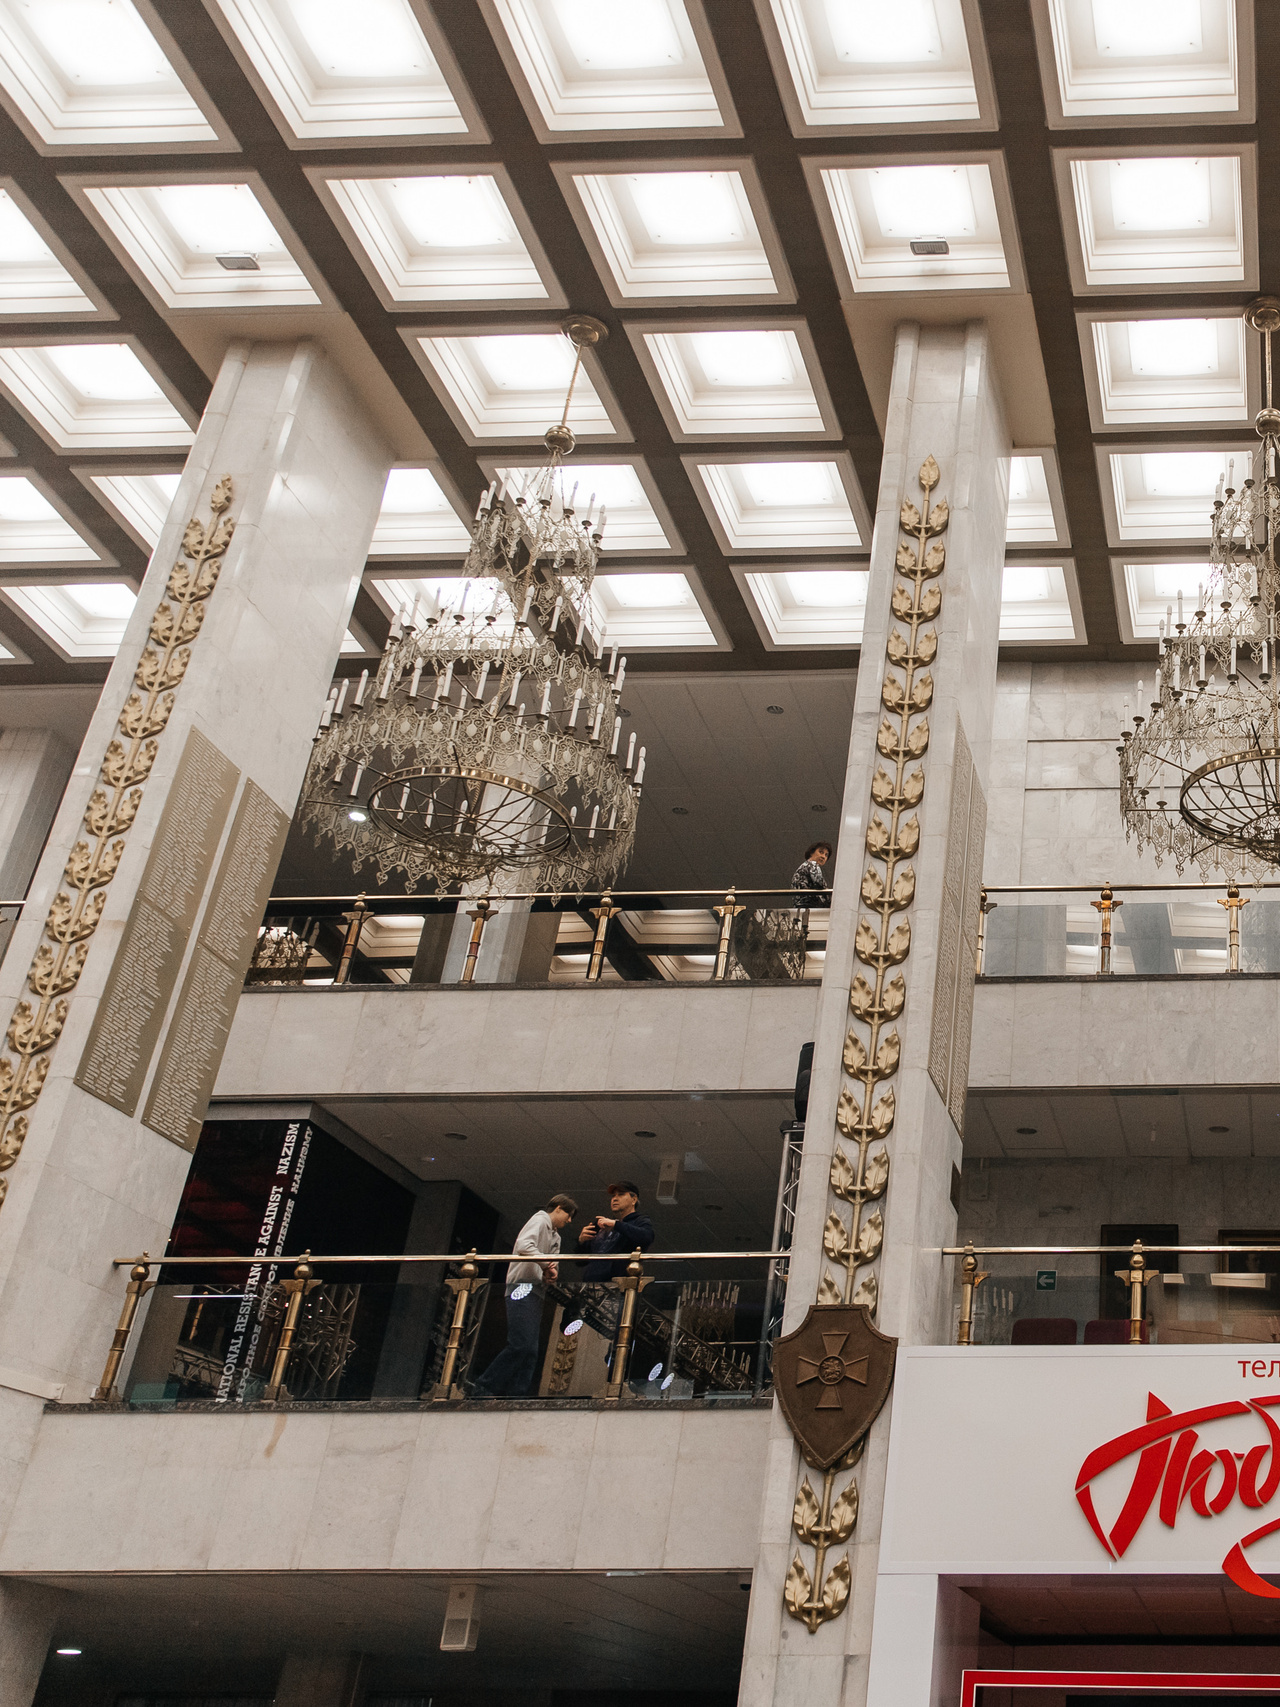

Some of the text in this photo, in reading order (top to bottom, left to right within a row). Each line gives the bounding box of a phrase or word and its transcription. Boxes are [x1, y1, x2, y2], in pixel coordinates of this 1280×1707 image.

[234, 1248, 267, 1333] RESISTANE
[258, 1185, 283, 1246] AGAINST
[276, 1123, 300, 1175] NAZISM
[257, 1199, 295, 1322] СОПРОТВЛЕНИЕ
